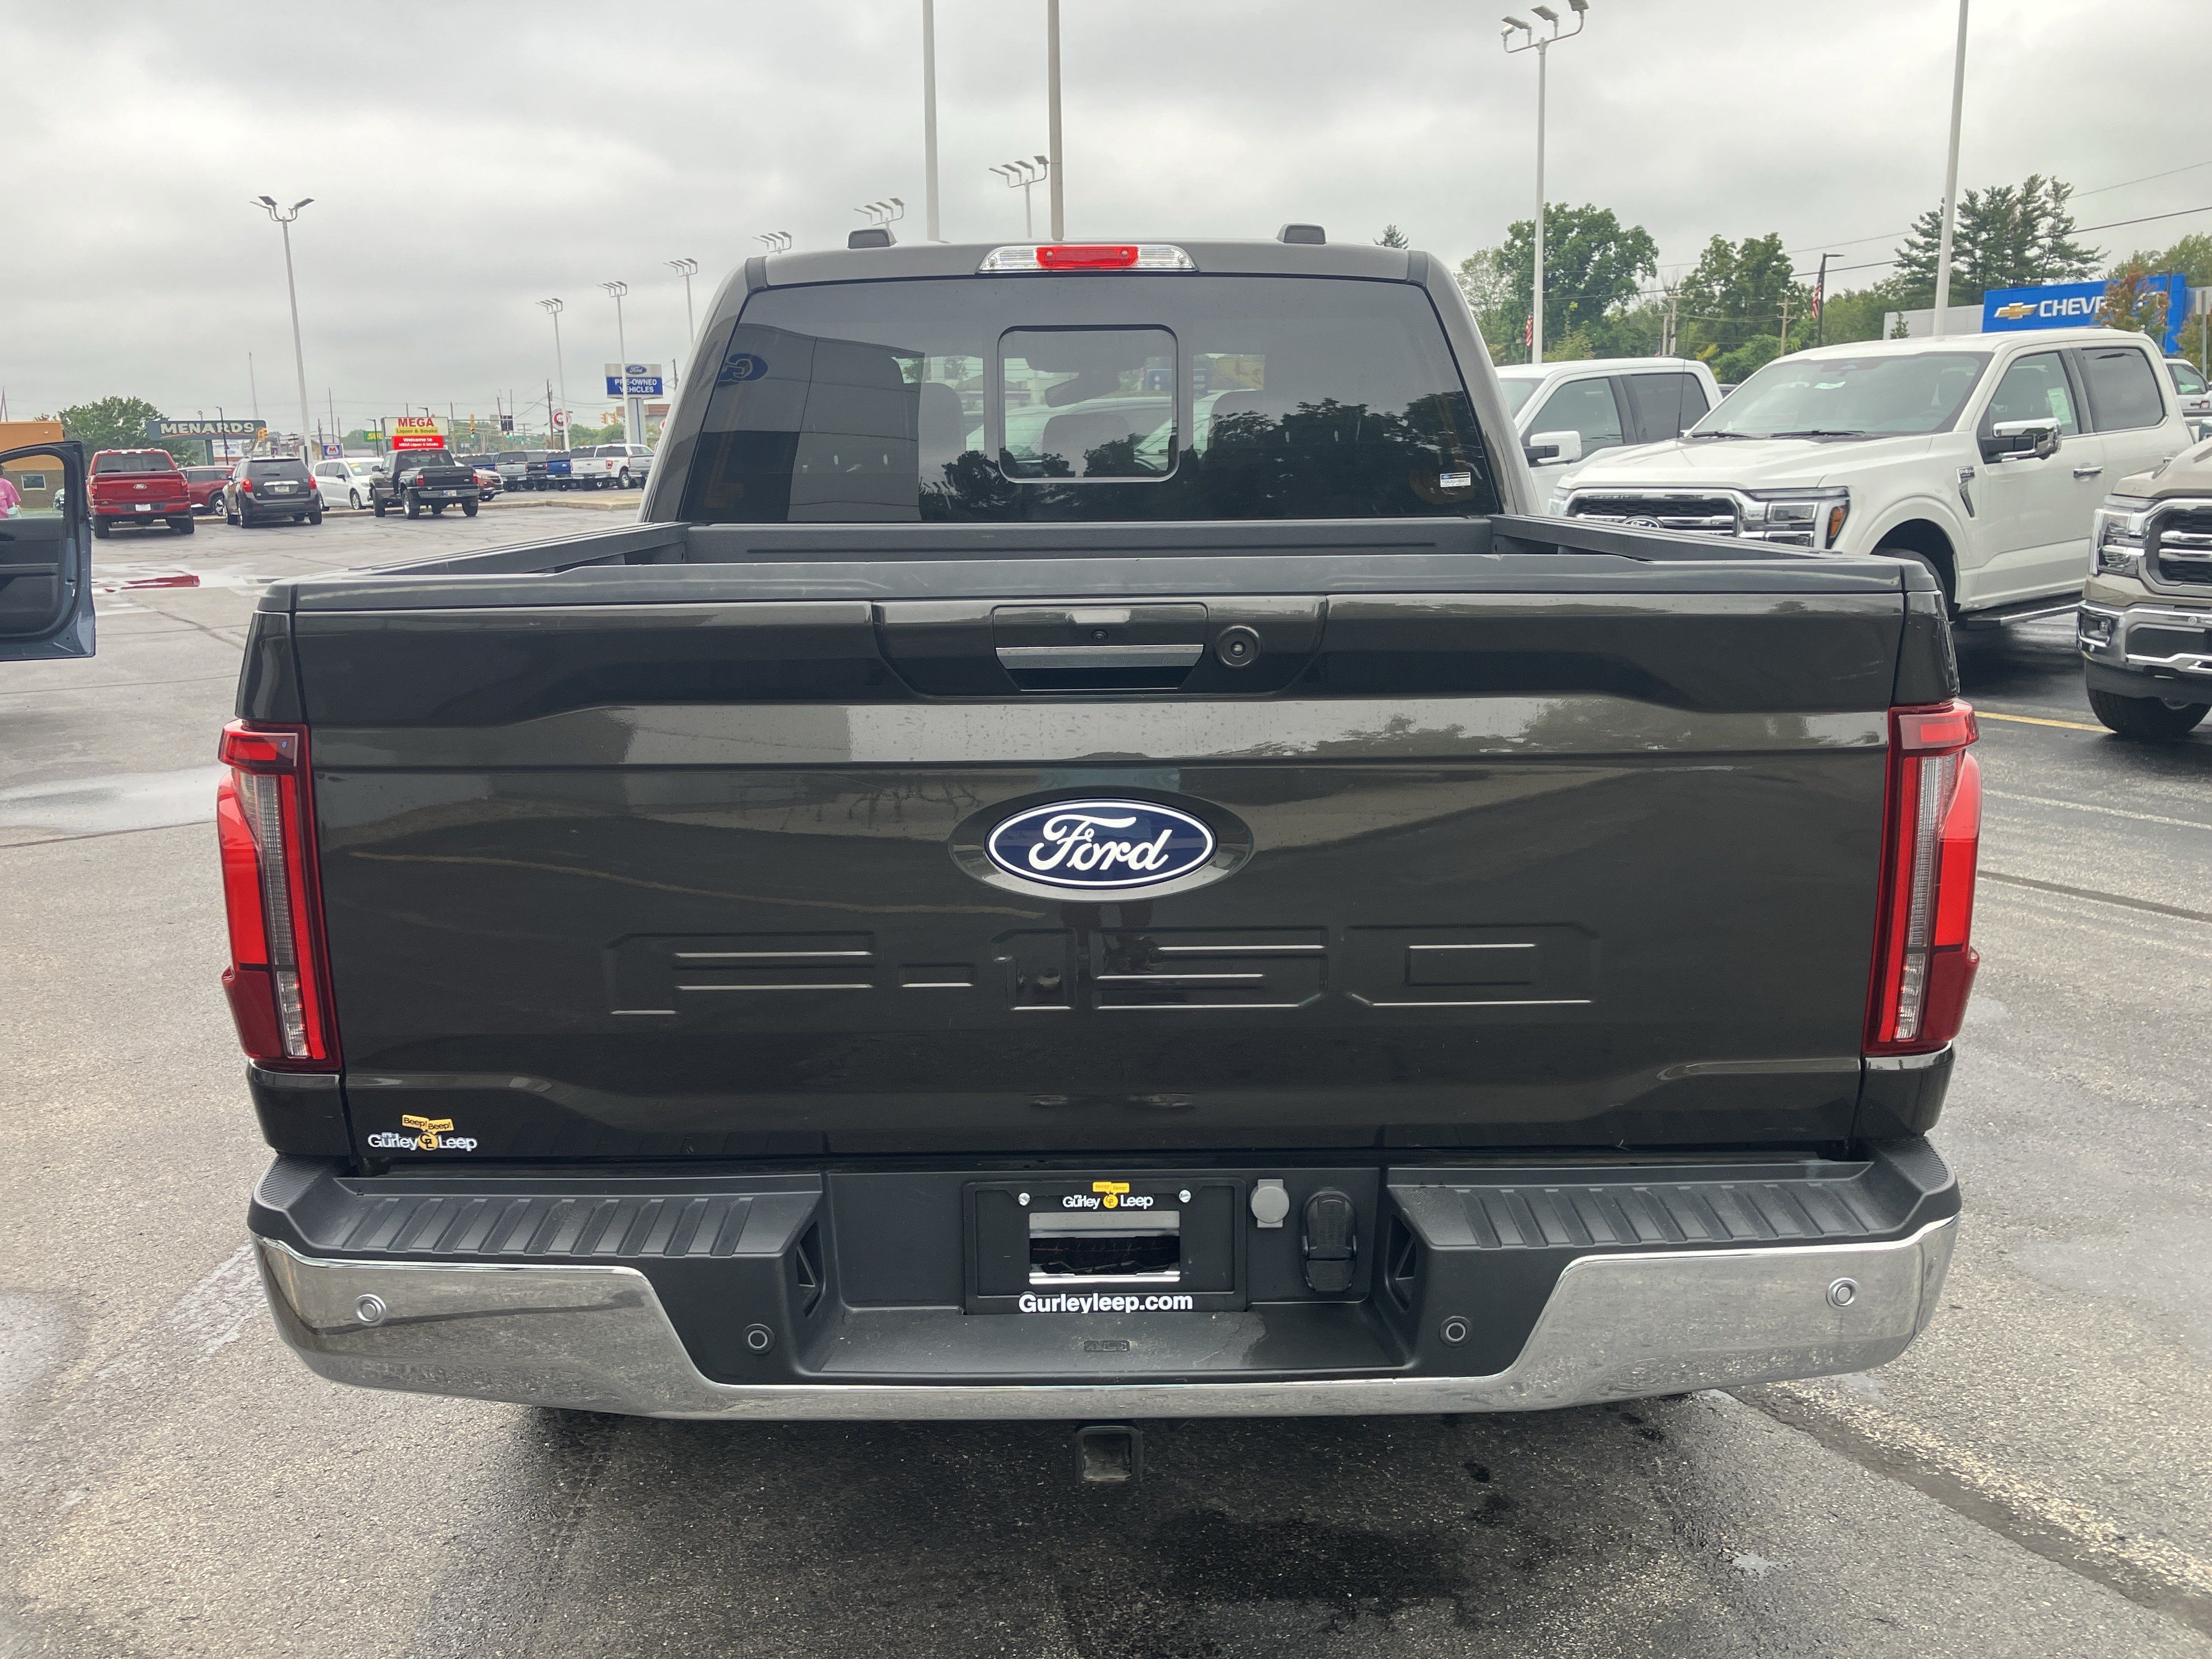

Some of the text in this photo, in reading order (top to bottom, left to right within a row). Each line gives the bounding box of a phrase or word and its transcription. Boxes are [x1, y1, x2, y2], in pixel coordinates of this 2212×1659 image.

[160, 422, 255, 434] MENARDS
[398, 417, 434, 427] MEGA
[1029, 814, 1172, 871] Ford
[607, 923, 1598, 1014] F-150
[403, 1117, 452, 1130] Beep! Beep!
[438, 1135, 478, 1151] Leep
[1120, 1194, 1154, 1210] Leep
[1019, 1293, 1193, 1313] Gurleyleep.com
